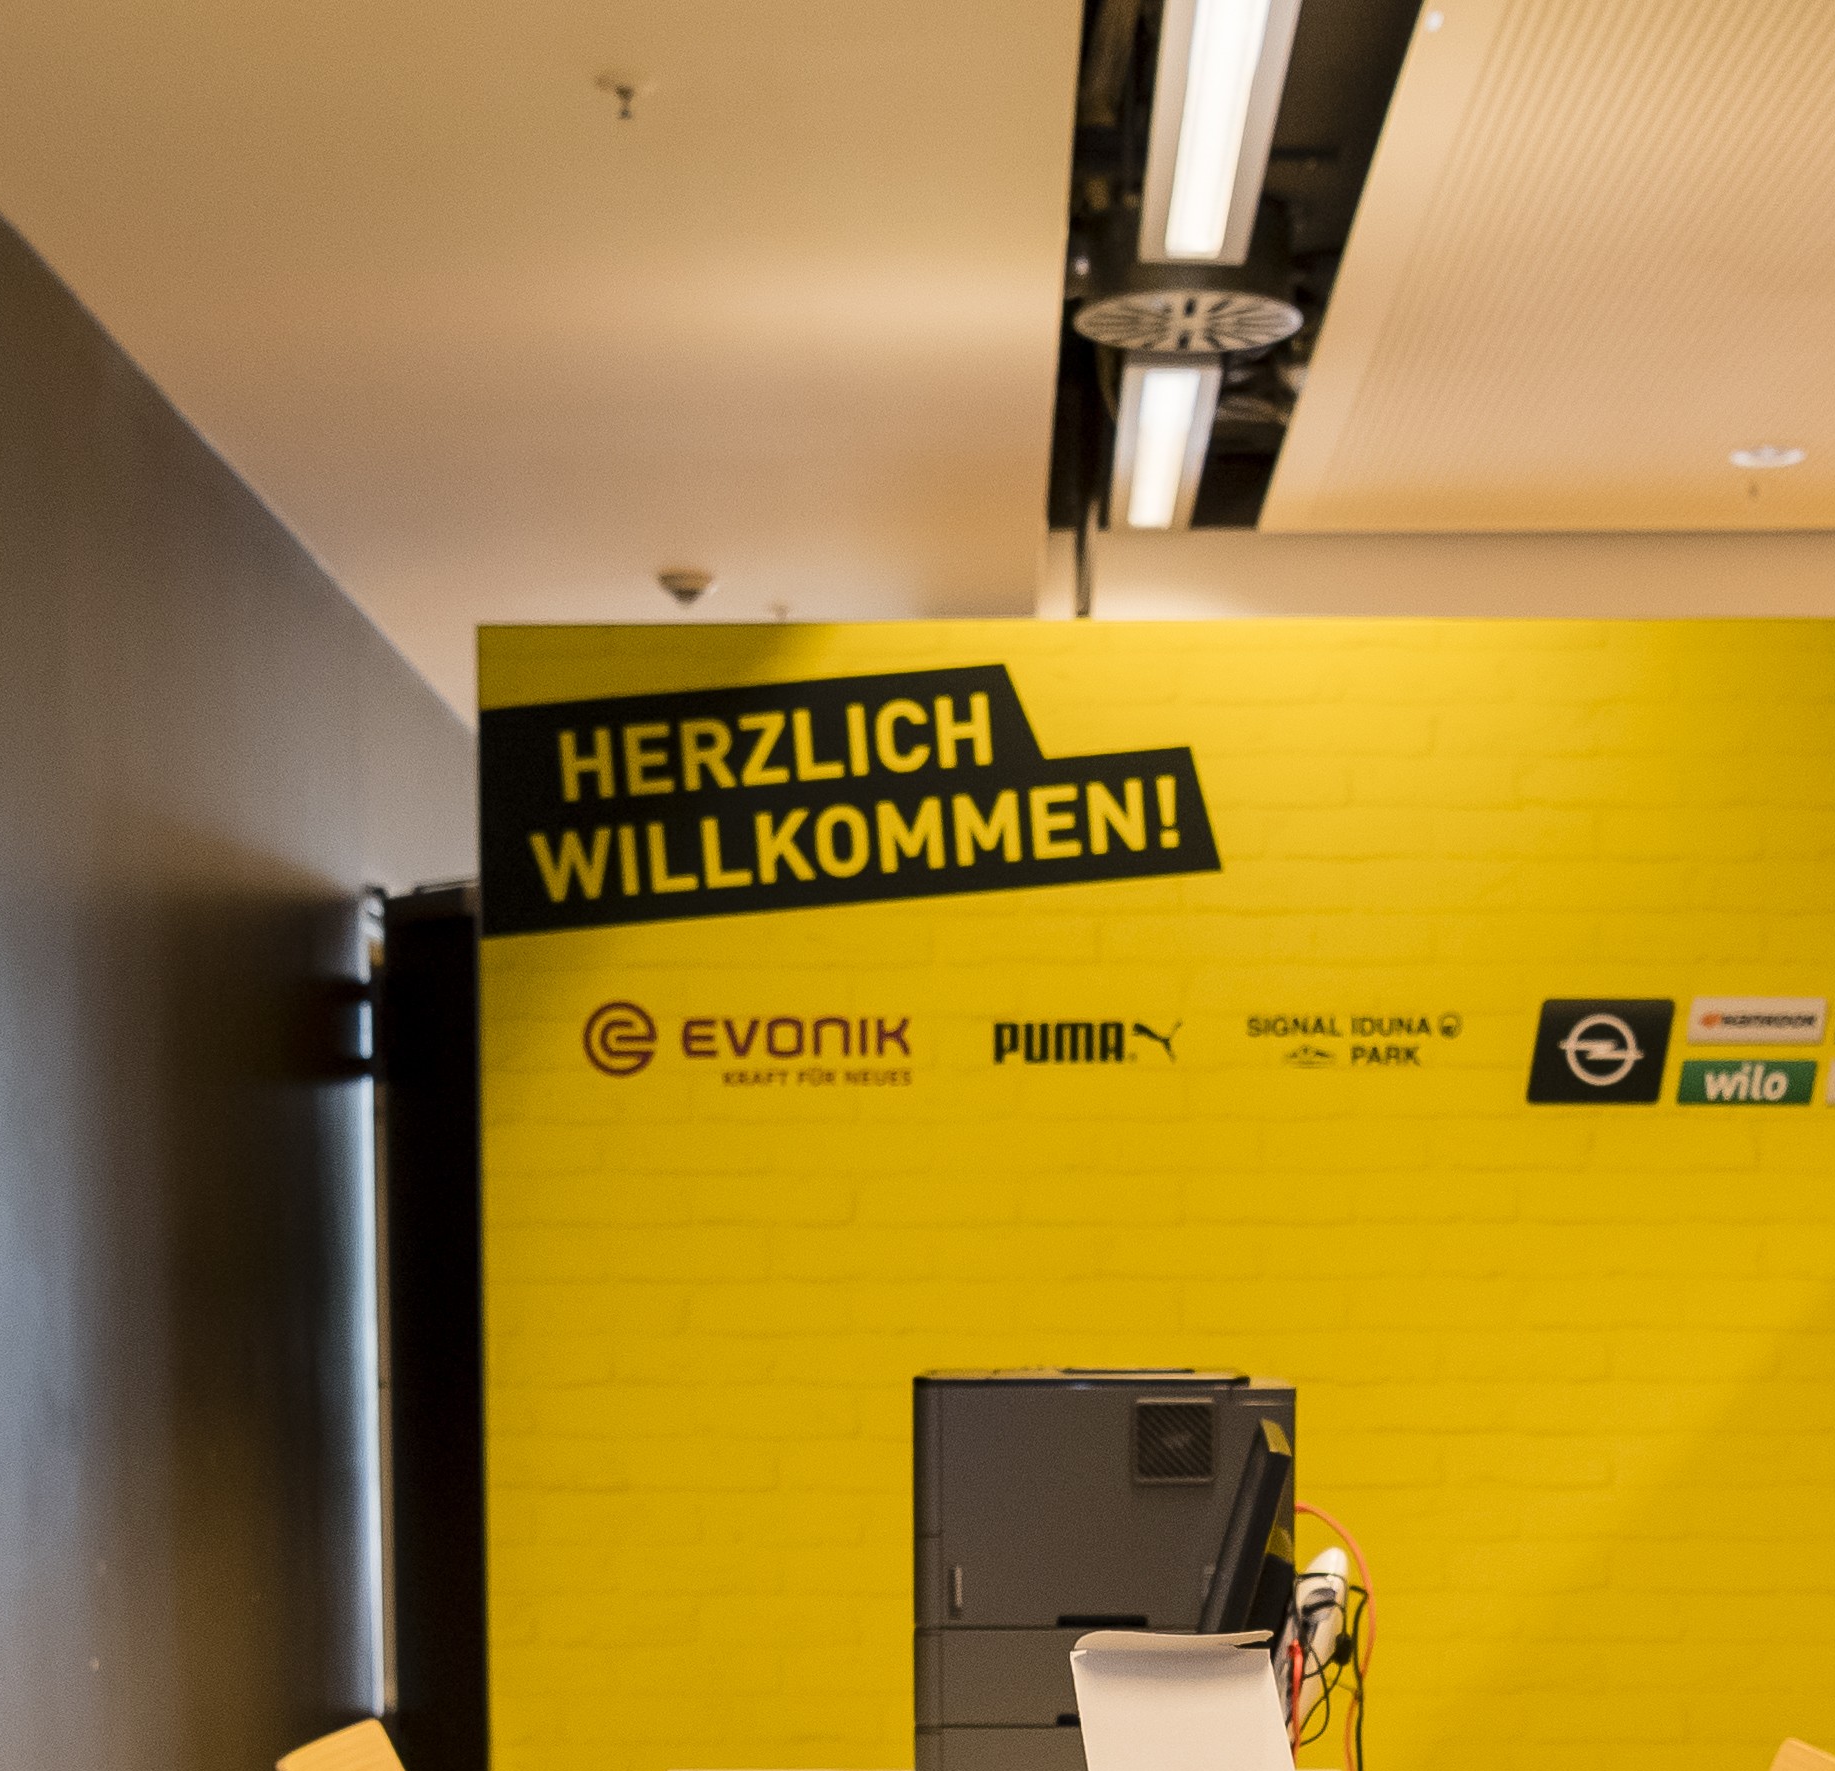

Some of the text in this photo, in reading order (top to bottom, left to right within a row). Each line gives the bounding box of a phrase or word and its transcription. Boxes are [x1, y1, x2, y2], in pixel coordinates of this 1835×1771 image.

[557, 690, 995, 803] HERZLICH
[529, 774, 1182, 904] WILLKOMMEN!
[680, 1015, 913, 1059] EVONIK
[994, 1020, 1126, 1064] PUMA
[1246, 1014, 1432, 1038] SIGNAL IDUNA
[1350, 1045, 1422, 1067] PARK
[1702, 1063, 1790, 1101] wilo
